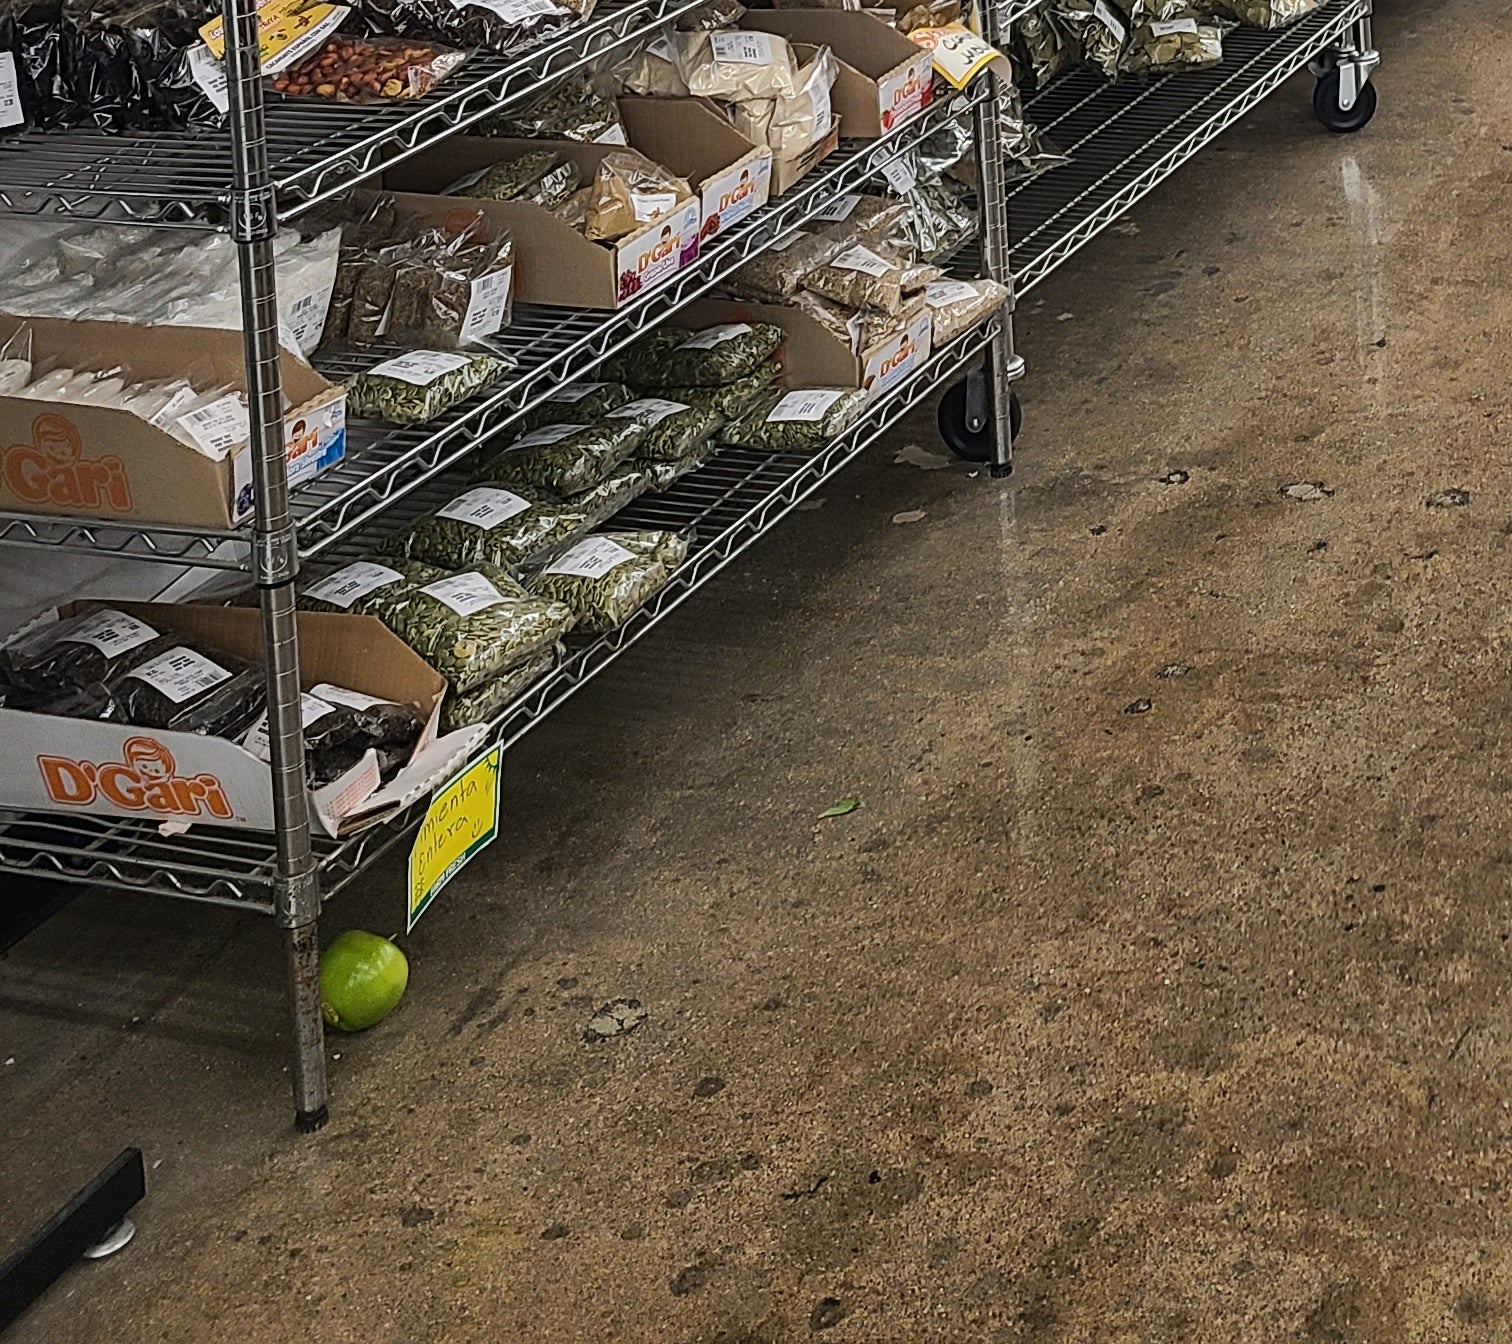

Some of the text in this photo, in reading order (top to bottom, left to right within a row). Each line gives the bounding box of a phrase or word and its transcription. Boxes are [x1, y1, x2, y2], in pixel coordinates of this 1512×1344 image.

[718, 176, 756, 213] D'Gari
[637, 230, 681, 275] D'Gari
[880, 339, 916, 379] D'Gari
[37, 755, 234, 820] D'Gari
